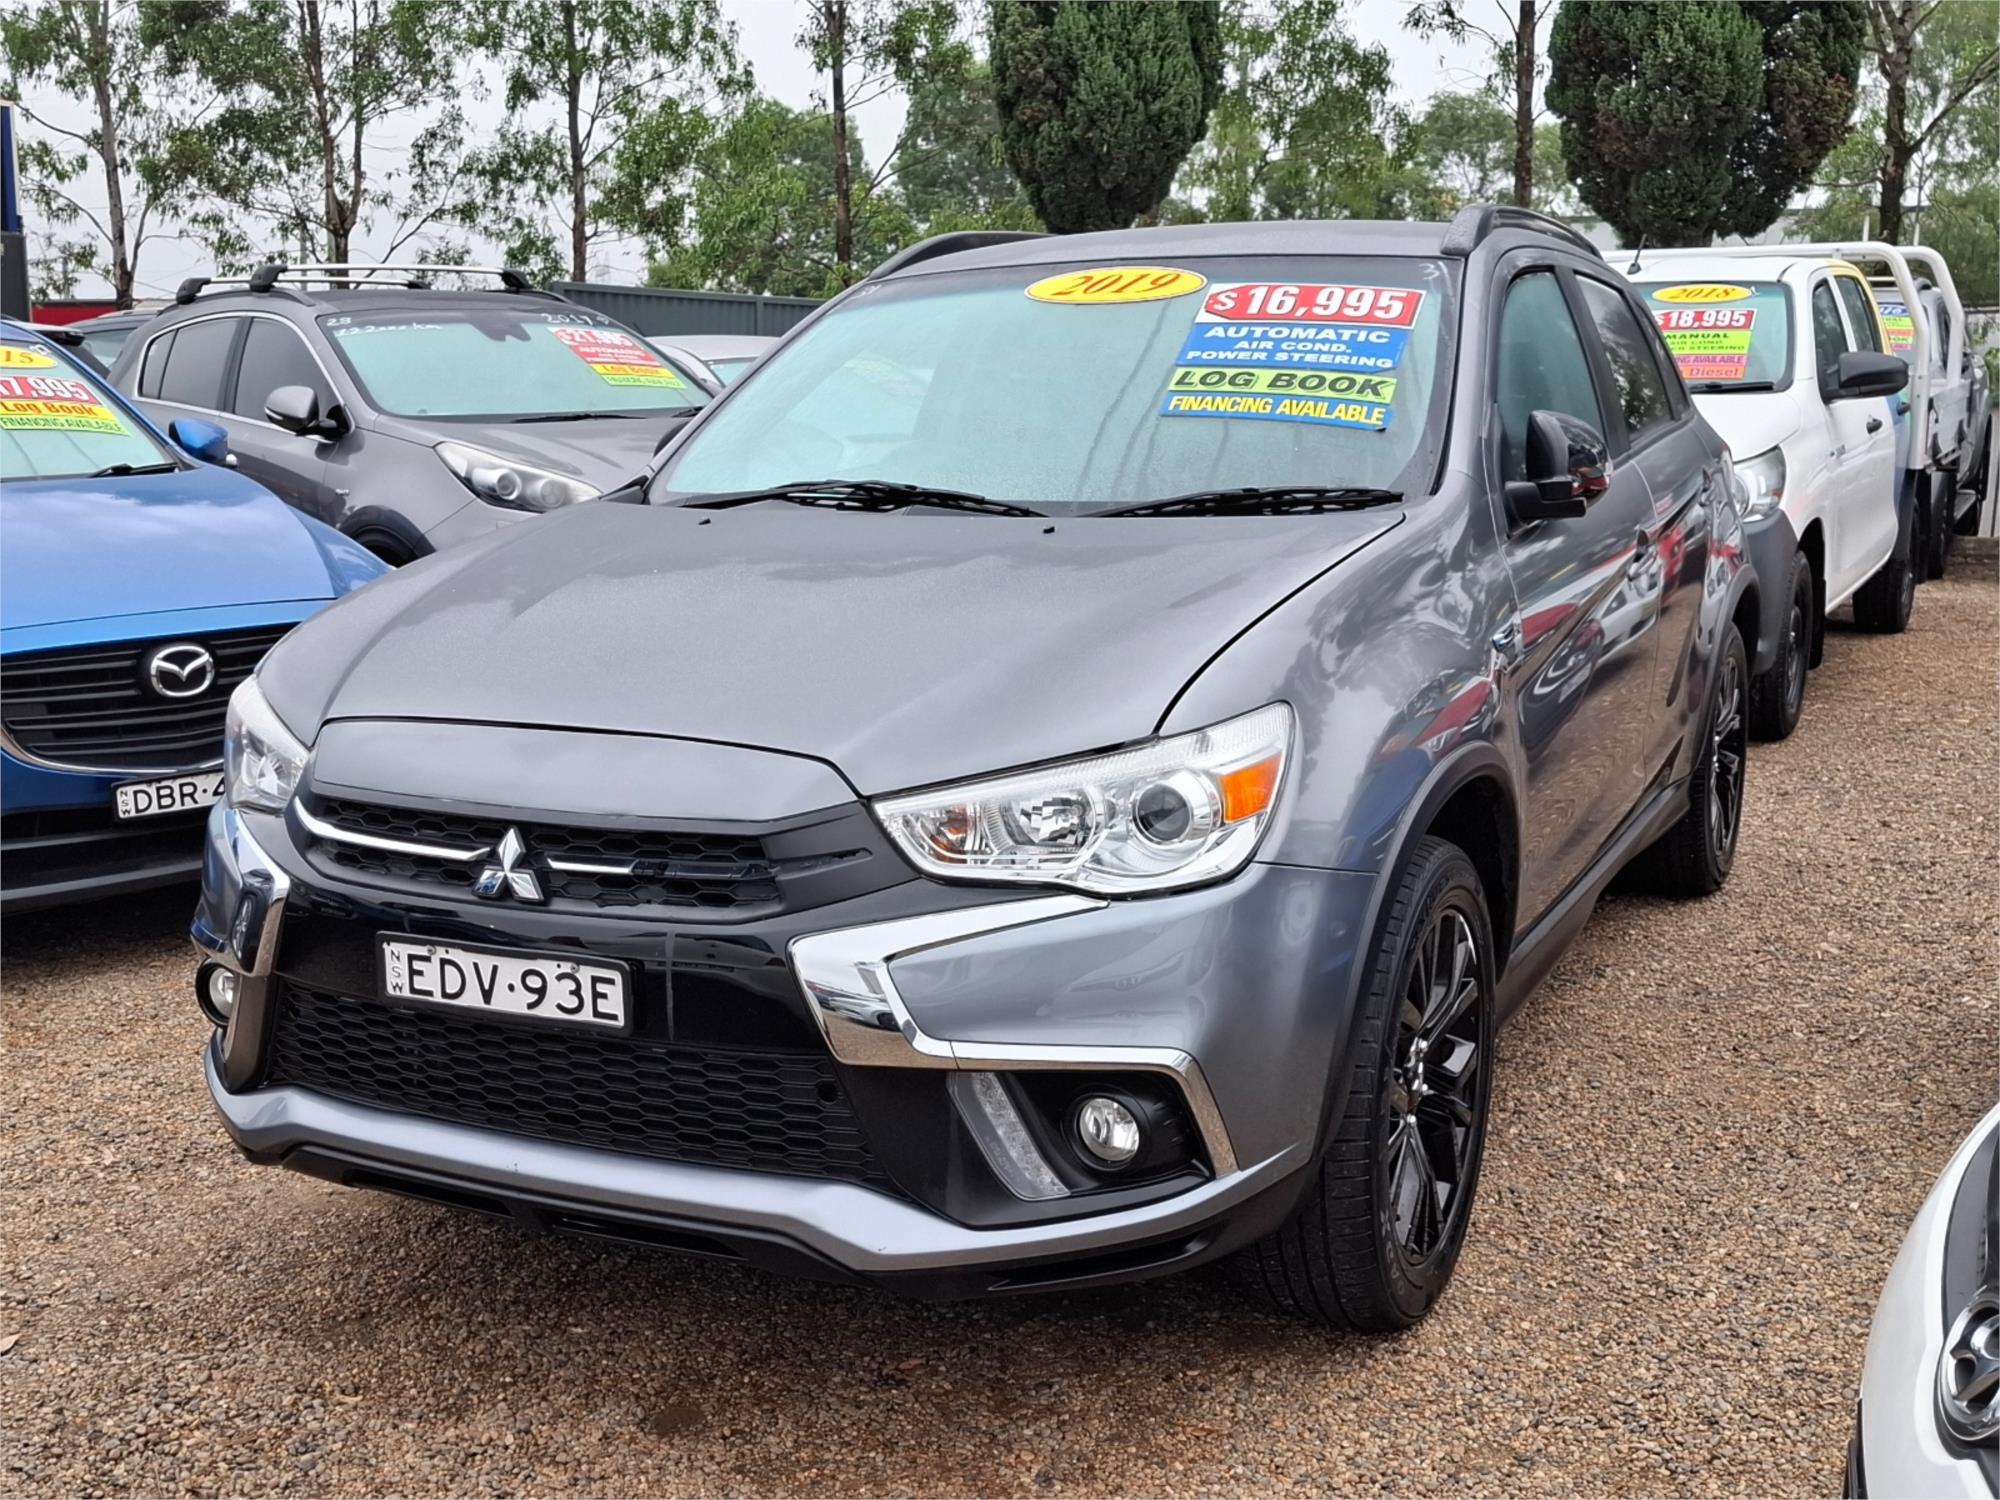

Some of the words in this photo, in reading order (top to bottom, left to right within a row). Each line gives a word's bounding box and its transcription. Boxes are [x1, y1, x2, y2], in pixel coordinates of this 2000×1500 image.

[1051, 273, 1181, 296] 2019
[1668, 288, 1736, 299] 2018
[1204, 326, 1392, 343] AUTOMATIC
[1234, 341, 1273, 350] AIR
[1281, 342, 1352, 353] COND.
[1186, 351, 1266, 360] POWER
[1274, 351, 1393, 368] STEERING
[1692, 355, 1744, 364] AVAILABLE
[1690, 366, 1738, 376] Diesel
[1174, 371, 1259, 389] LOG
[1267, 373, 1391, 400] BOOK
[0, 402, 42, 415] Log
[43, 402, 98, 416] Book
[1168, 395, 1273, 413] FINANCING
[1275, 399, 1386, 425] AVAILABLE
[120, 790, 131, 816] NSW
[390, 950, 405, 993] NSW
